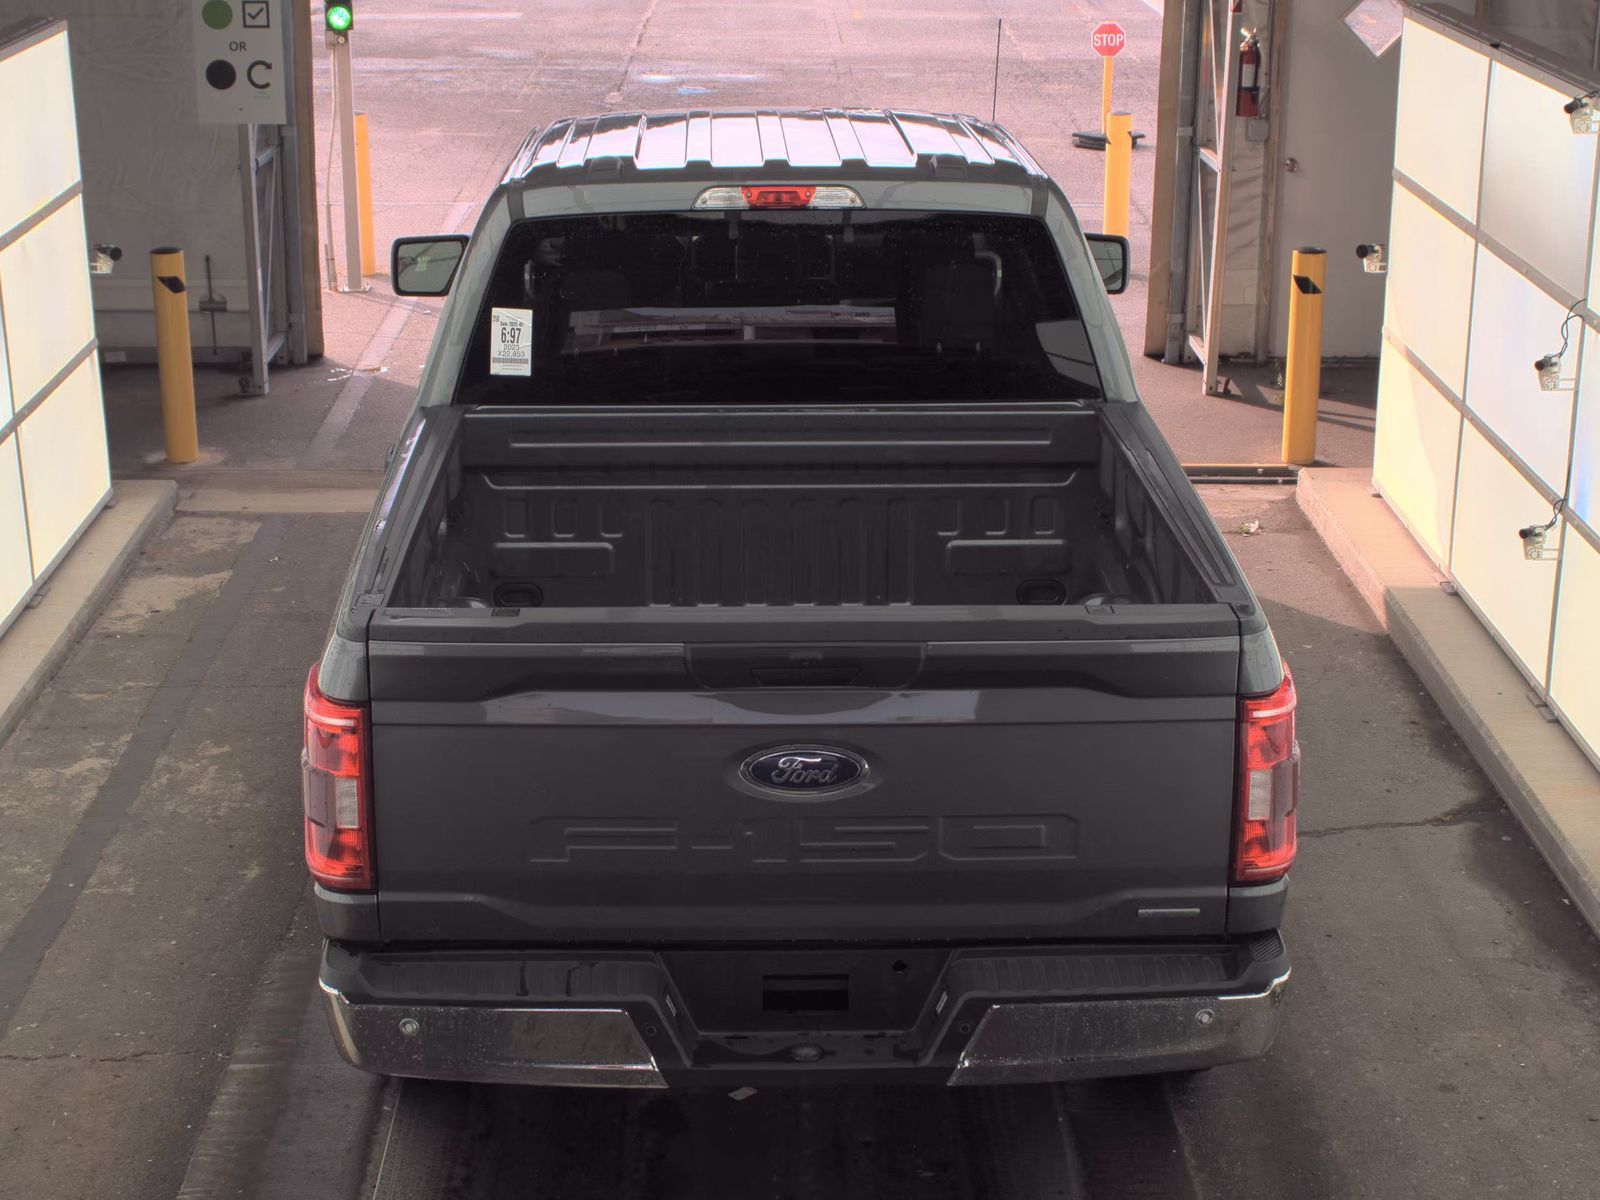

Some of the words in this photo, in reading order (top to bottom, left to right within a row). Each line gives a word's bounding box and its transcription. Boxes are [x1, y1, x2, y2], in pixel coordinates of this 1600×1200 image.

[229, 41, 247, 52] OR
[1093, 33, 1124, 47] STOP
[771, 756, 839, 783] Ford
[530, 814, 1079, 863] F-150
